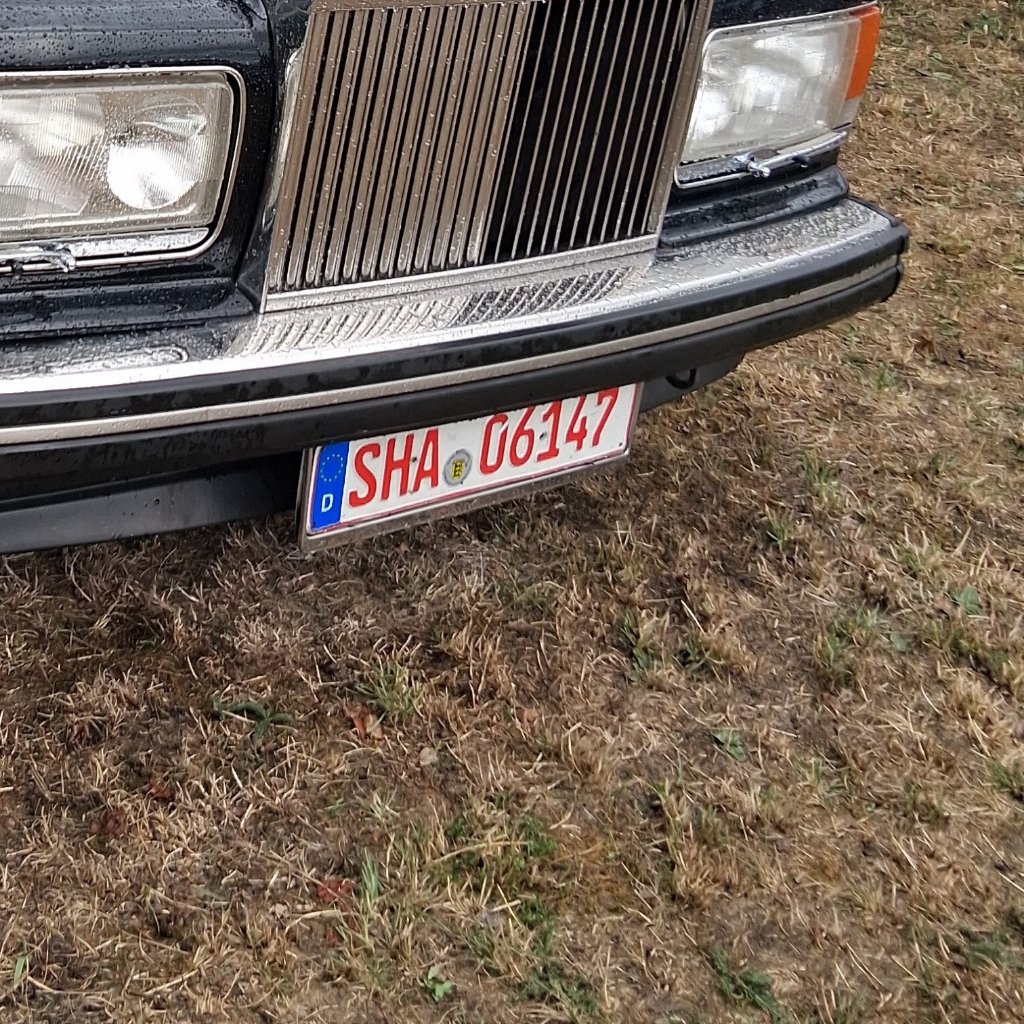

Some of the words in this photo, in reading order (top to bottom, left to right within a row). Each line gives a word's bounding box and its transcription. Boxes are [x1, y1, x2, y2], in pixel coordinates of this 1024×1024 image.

[320, 493, 334, 513] D
[349, 428, 439, 508] SHA
[479, 387, 619, 475] 06147
